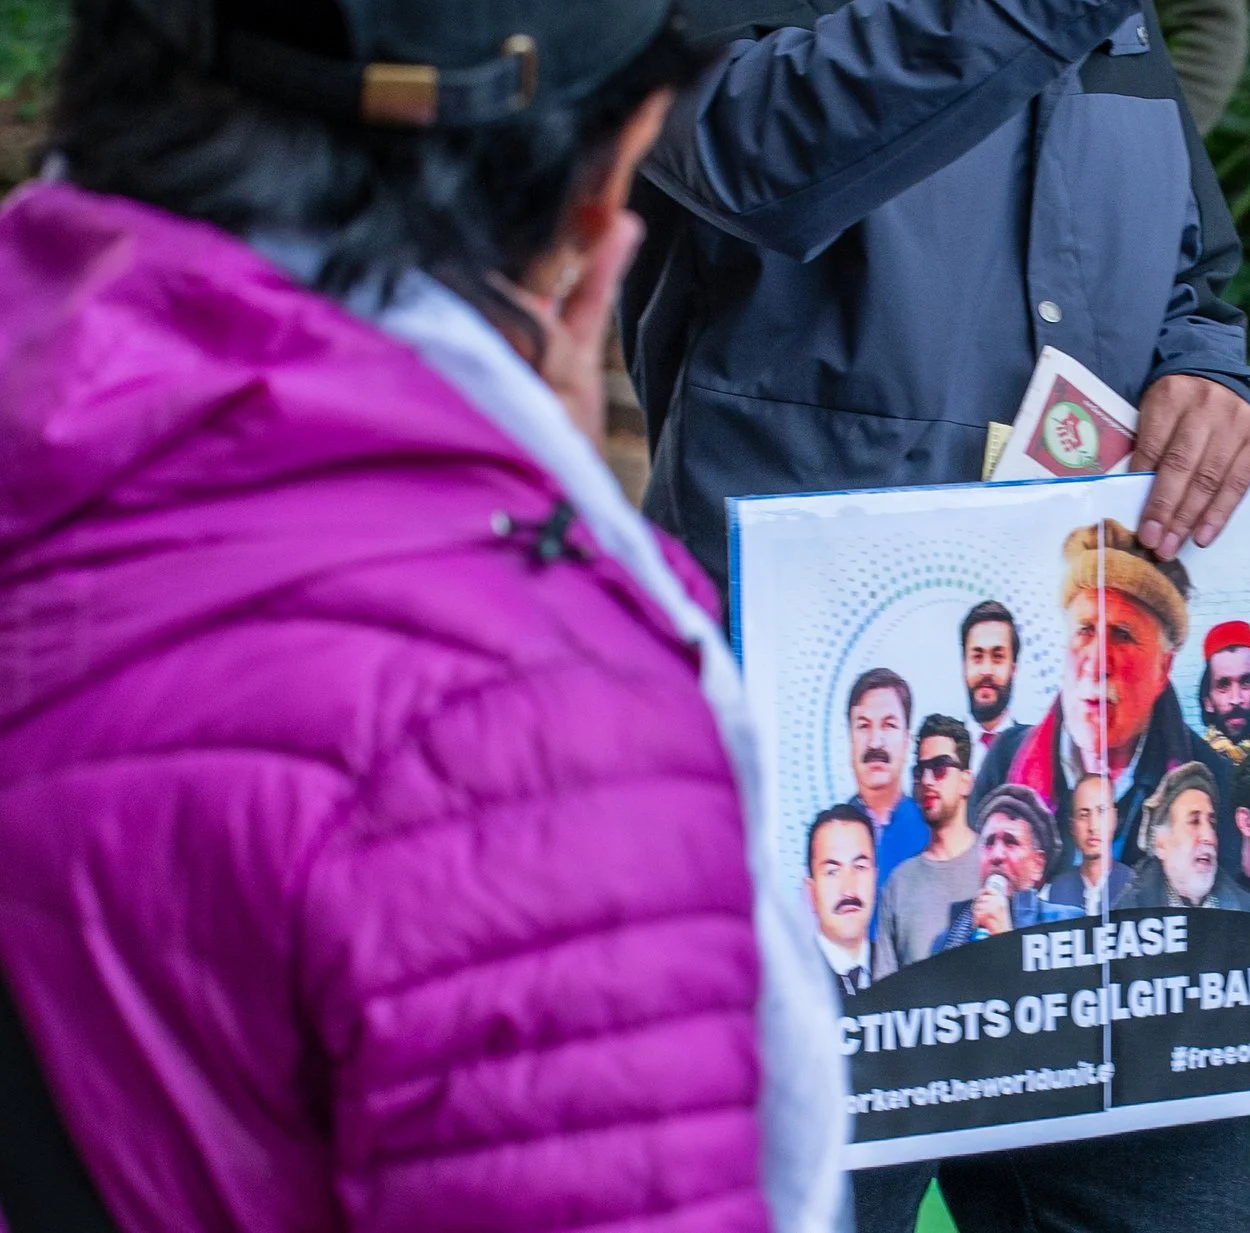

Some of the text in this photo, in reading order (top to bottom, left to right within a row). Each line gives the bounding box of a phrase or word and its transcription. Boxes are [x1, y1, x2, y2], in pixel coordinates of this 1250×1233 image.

[1022, 915, 1188, 972] RELEASE
[837, 999, 1012, 1055] CTIVISTS
[1014, 993, 1068, 1034] OF
[846, 1061, 1115, 1114] orkeroftheworldunite
